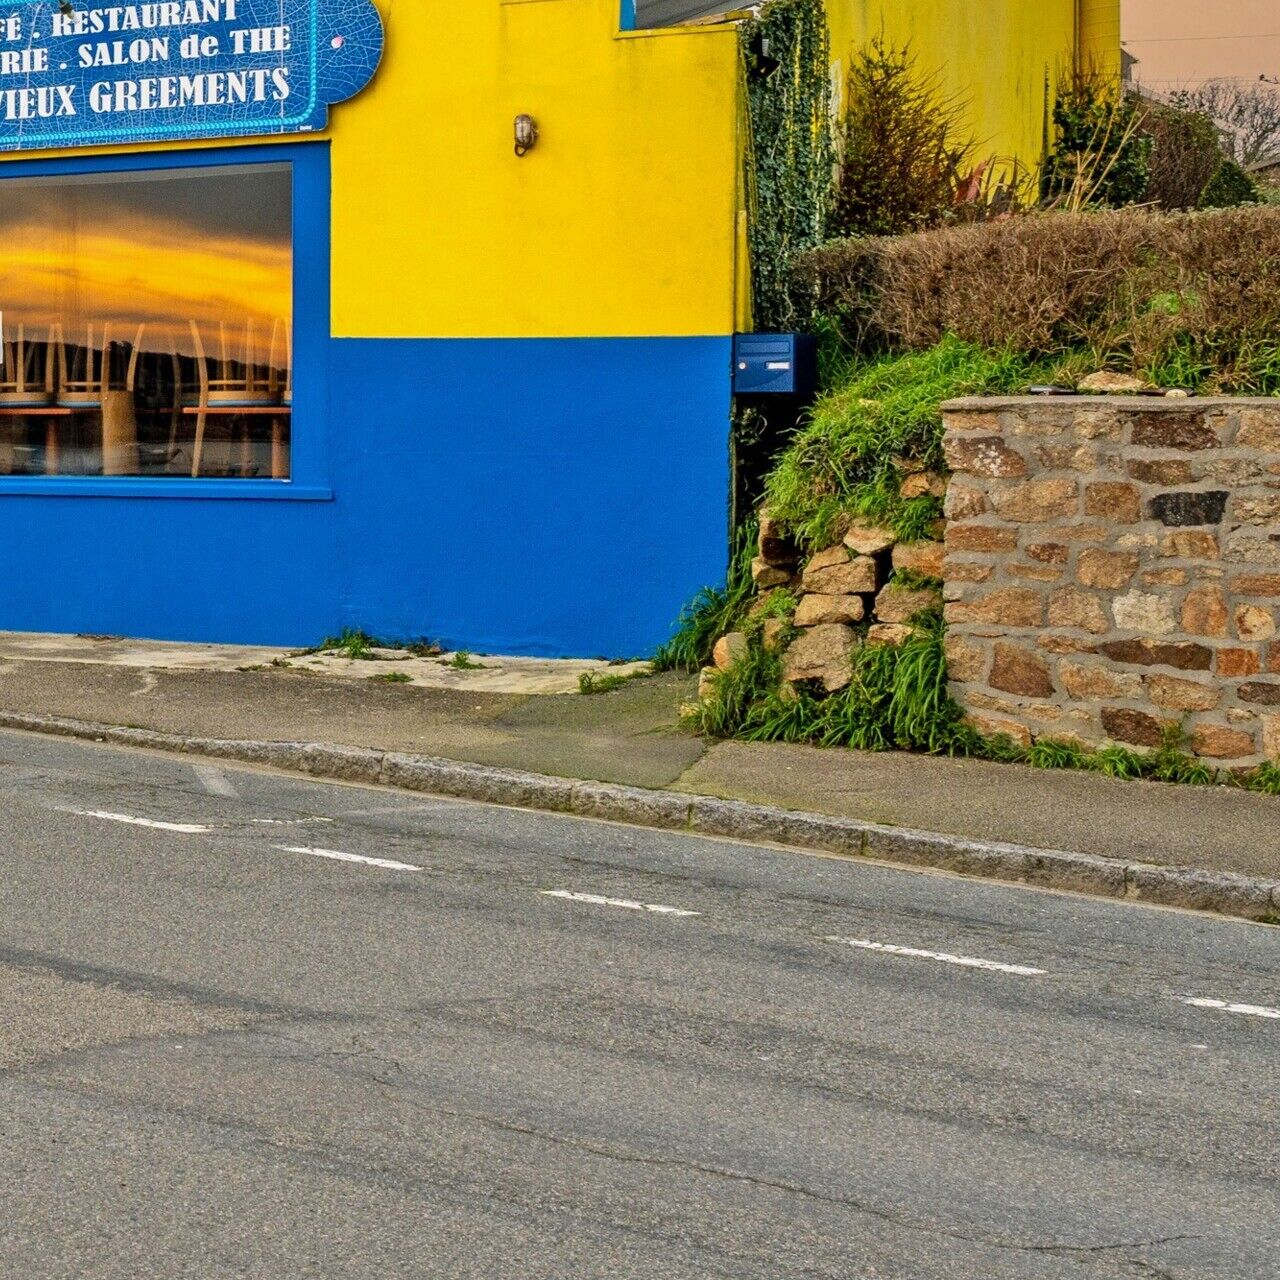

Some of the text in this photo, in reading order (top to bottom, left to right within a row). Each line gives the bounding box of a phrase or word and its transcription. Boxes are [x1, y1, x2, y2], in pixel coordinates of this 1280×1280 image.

[78, 37, 169, 69] SALON
[180, 34, 219, 60] de
[229, 25, 291, 55] THE
[89, 67, 290, 114] GREEMENTS
